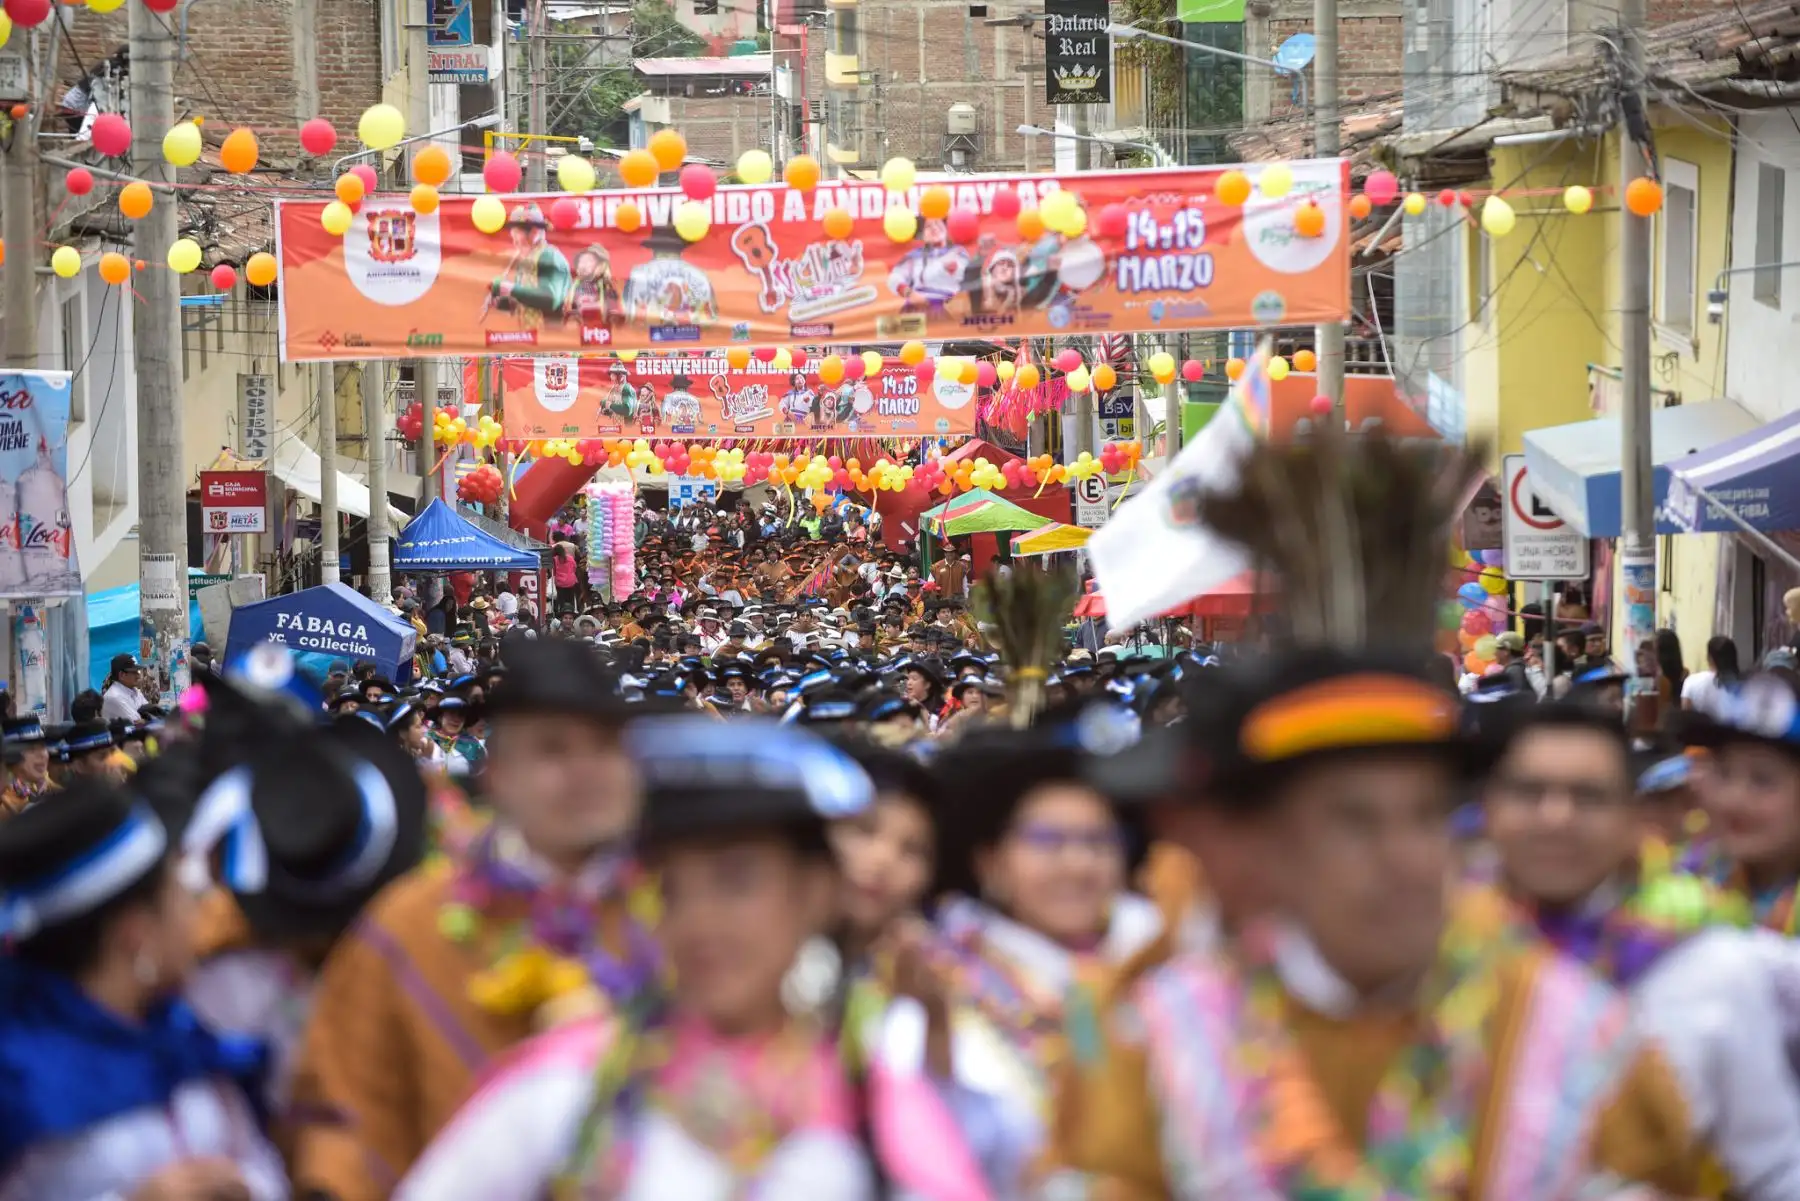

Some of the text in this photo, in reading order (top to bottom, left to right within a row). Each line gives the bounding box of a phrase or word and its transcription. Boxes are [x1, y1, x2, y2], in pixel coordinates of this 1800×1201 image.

[1047, 13, 1108, 36] Palacio
[1059, 37, 1097, 56] Real
[782, 189, 806, 222] A
[1117, 253, 1214, 294] MARZO
[583, 326, 610, 344] irtp
[636, 359, 729, 375] BIENVENIDO
[879, 397, 920, 415] MARZO
[1104, 402, 1134, 414] BBV
[1086, 478, 1099, 498] E
[417, 535, 477, 547] WANXIN
[276, 612, 368, 641] FÁBAGA
